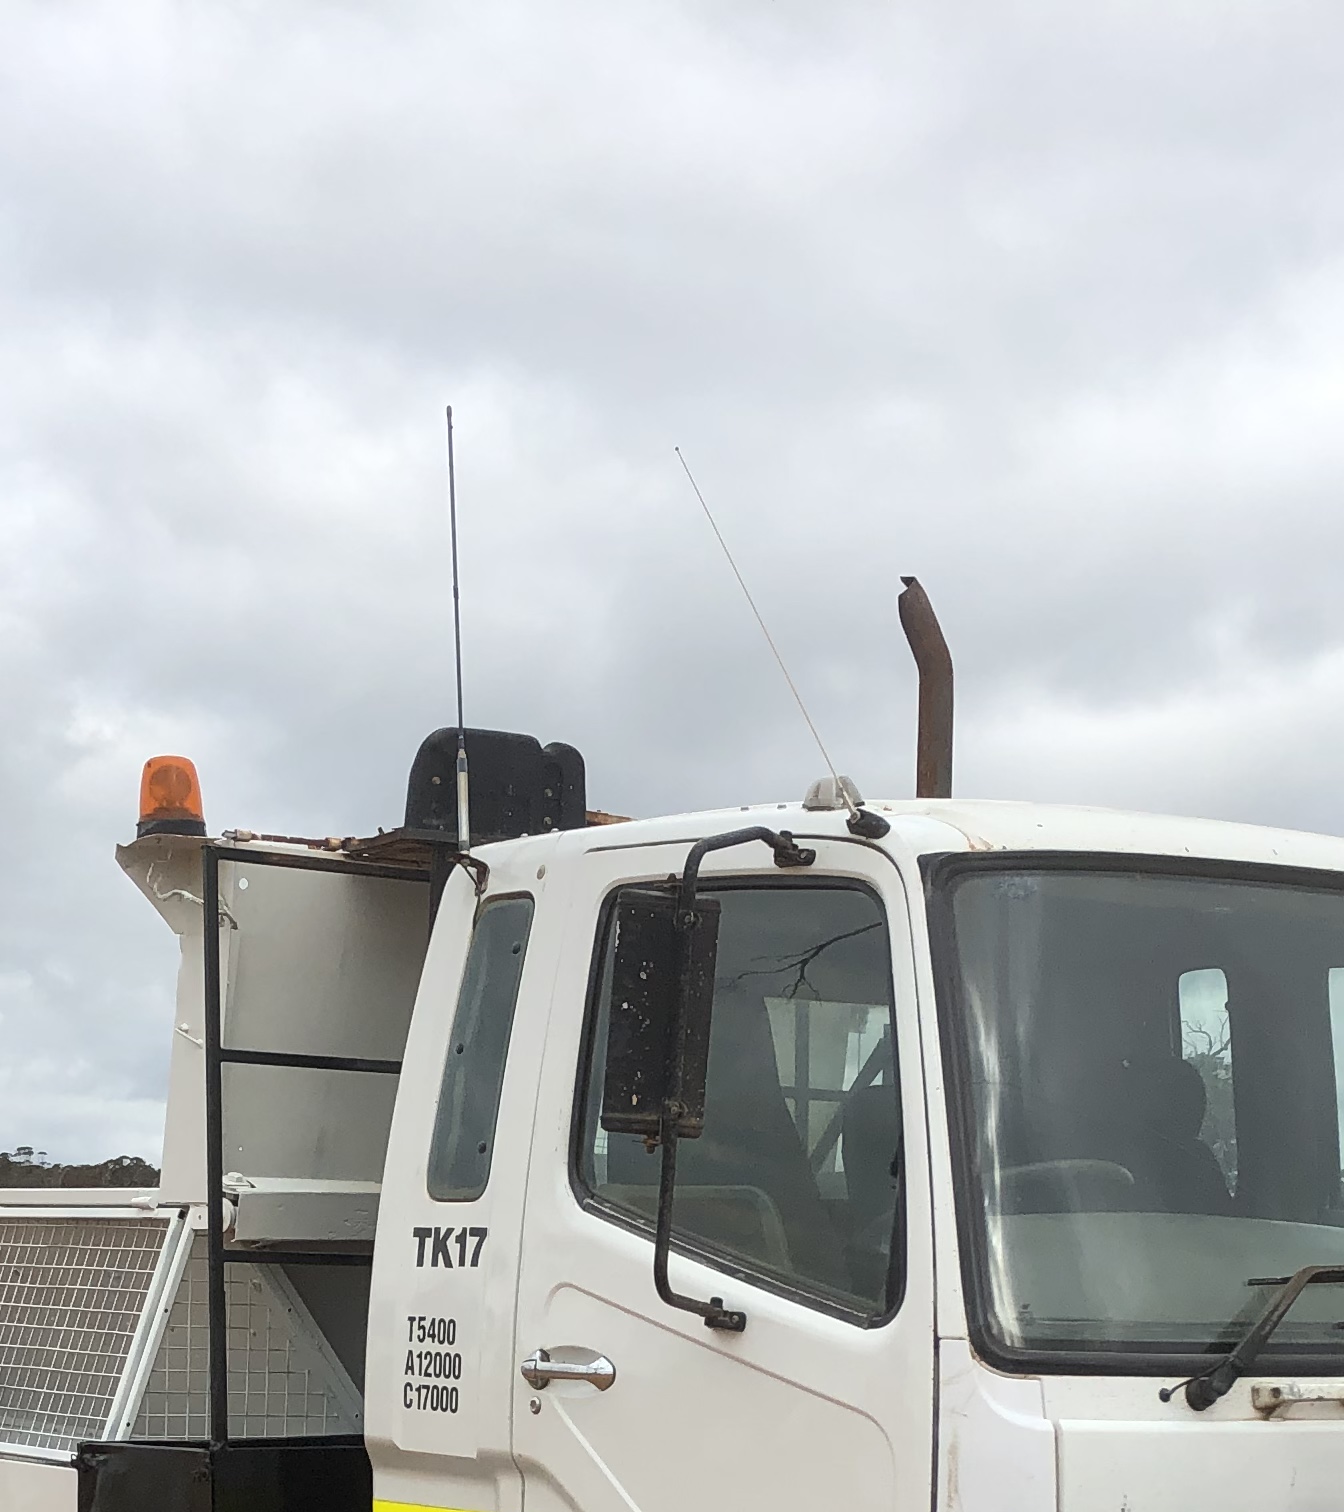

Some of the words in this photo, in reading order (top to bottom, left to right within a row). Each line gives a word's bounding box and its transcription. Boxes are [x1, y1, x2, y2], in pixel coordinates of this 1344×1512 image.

[413, 1227, 488, 1269] TK17
[407, 1316, 457, 1345] T5400
[404, 1350, 462, 1380] A12000
[403, 1382, 459, 1414] C17000
